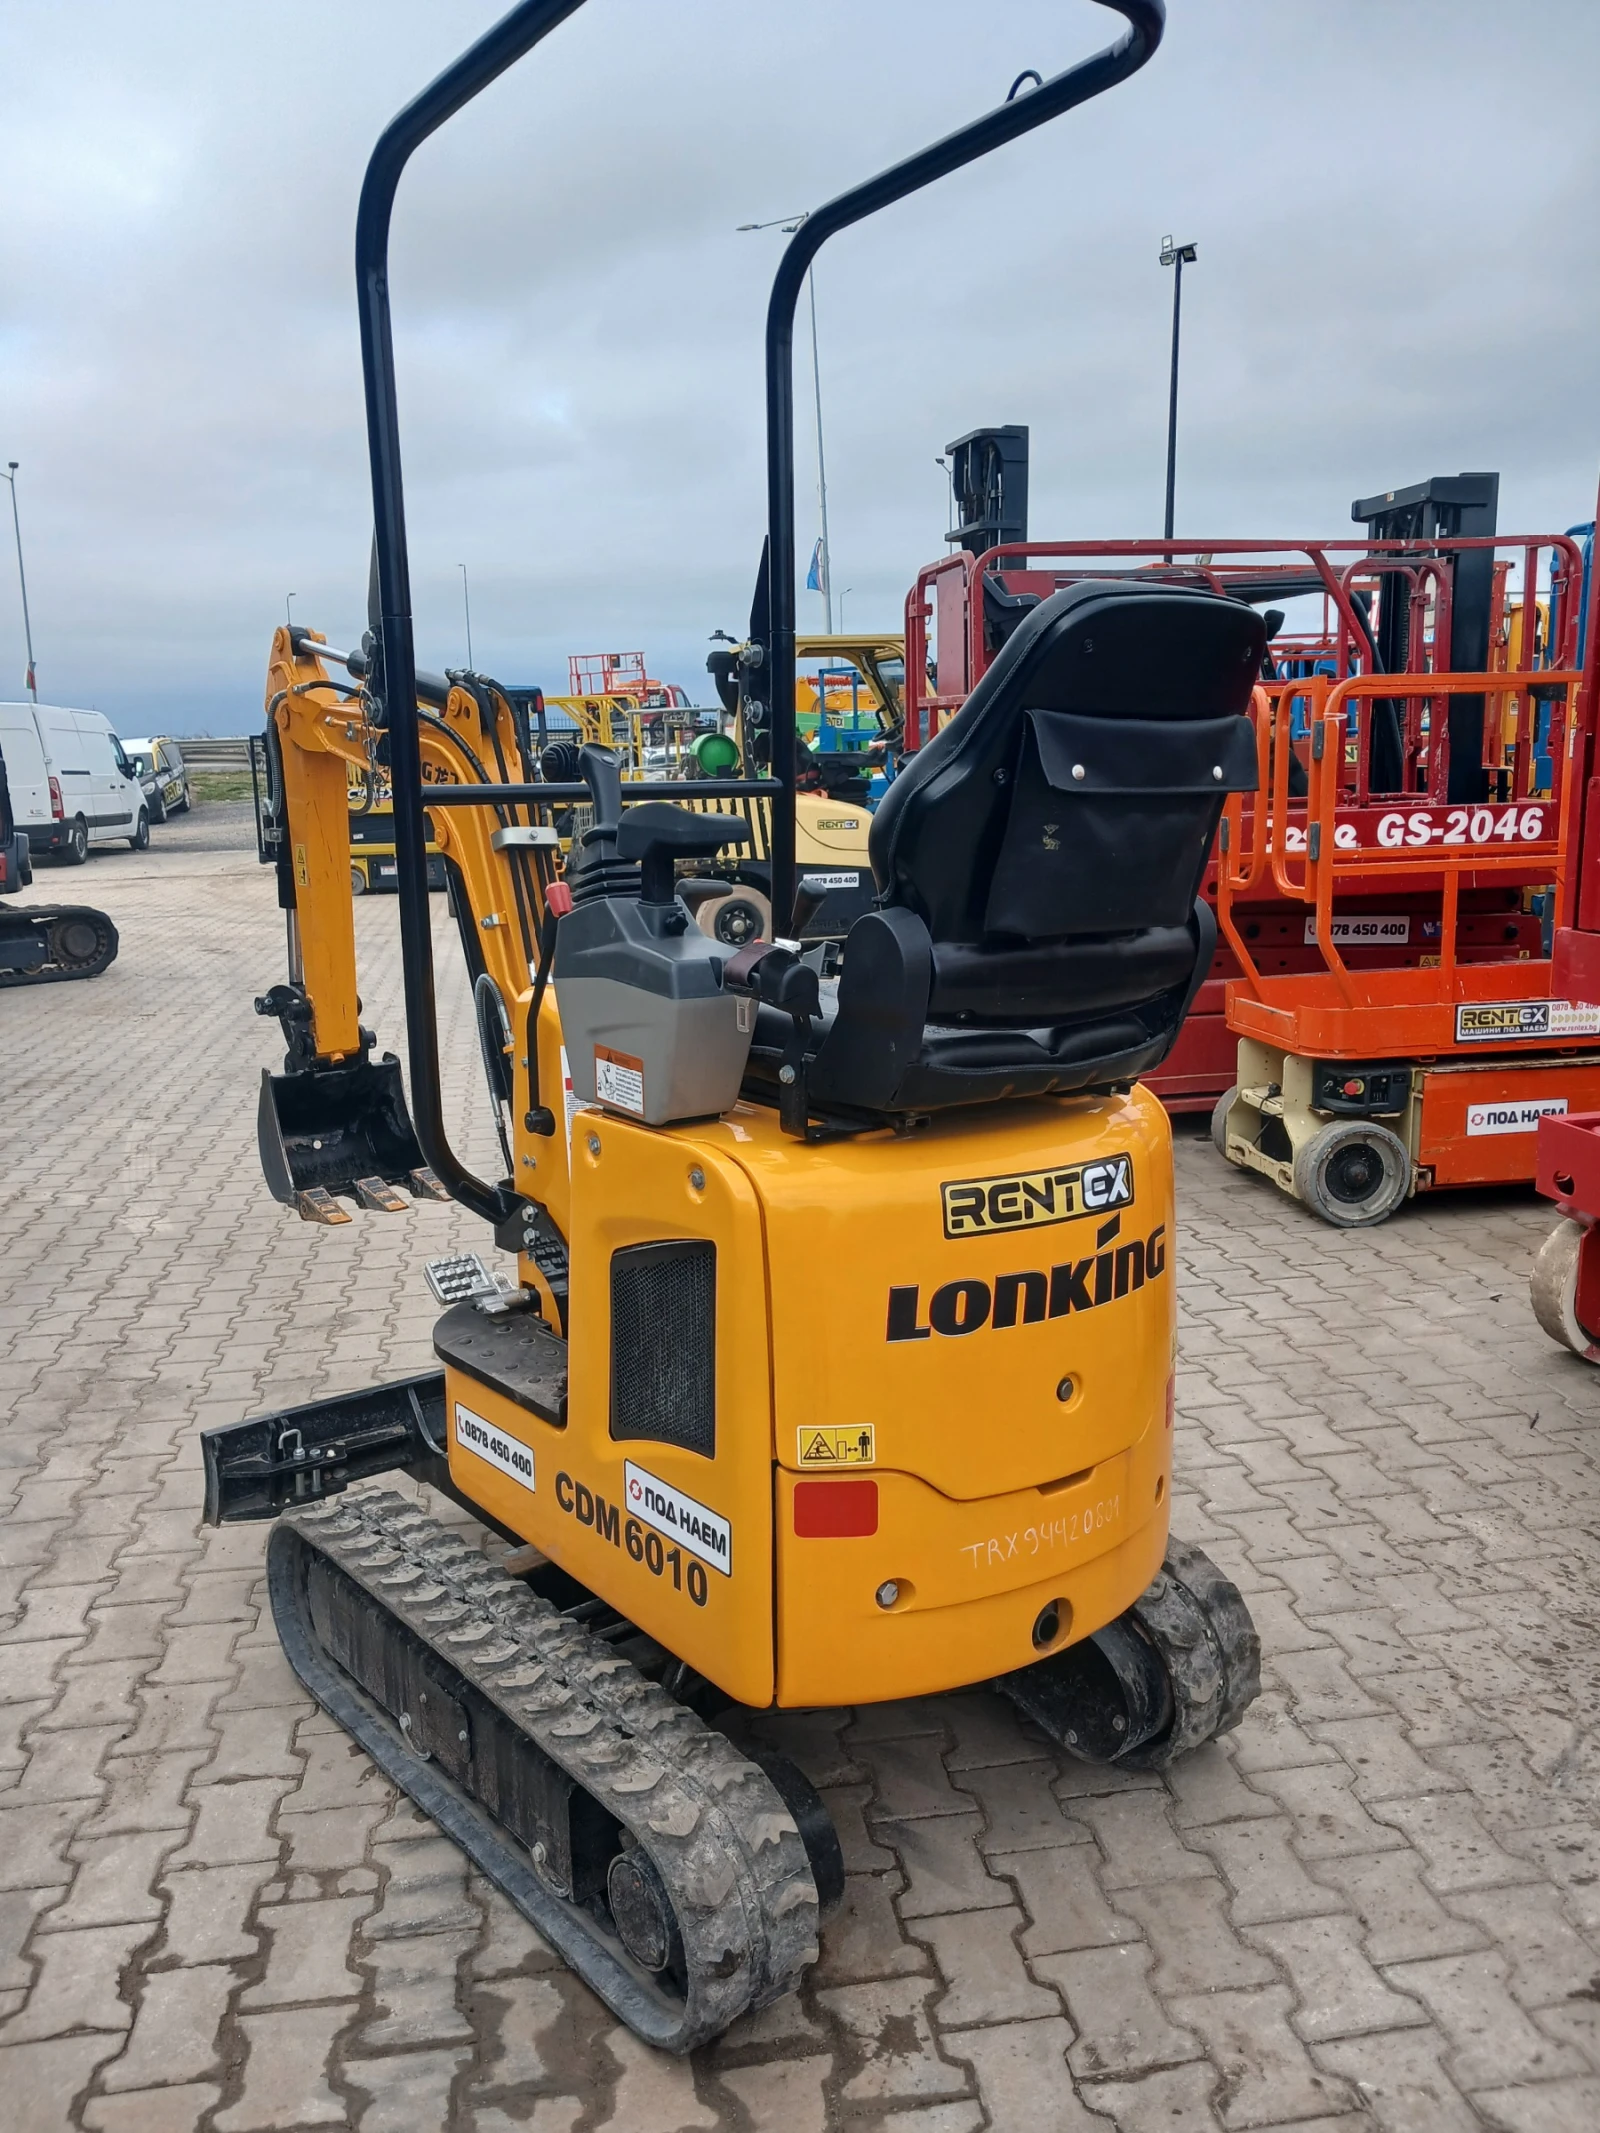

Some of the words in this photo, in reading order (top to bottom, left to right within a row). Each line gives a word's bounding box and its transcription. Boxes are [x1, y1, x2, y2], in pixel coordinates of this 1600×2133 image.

[819, 820, 857, 829] RENTEX
[1377, 807, 1544, 847] GS-2046
[843, 876, 857, 884] 400
[1330, 924, 1350, 936] 78
[1352, 924, 1378, 936] 450
[1380, 923, 1406, 936] 400
[1463, 1007, 1546, 1027] RENTEX
[1461, 1027, 1501, 1035] МАШИНИ
[1522, 1024, 1547, 1032] НАЕМ
[1487, 1111, 1518, 1125] ПОД
[950, 1161, 1130, 1229] RENTEX
[465, 1420, 489, 1449] 0878
[490, 1437, 510, 1463] 450
[511, 1451, 532, 1477] 400
[645, 1486, 678, 1526] ПОД
[679, 1507, 727, 1557] НАЕМ
